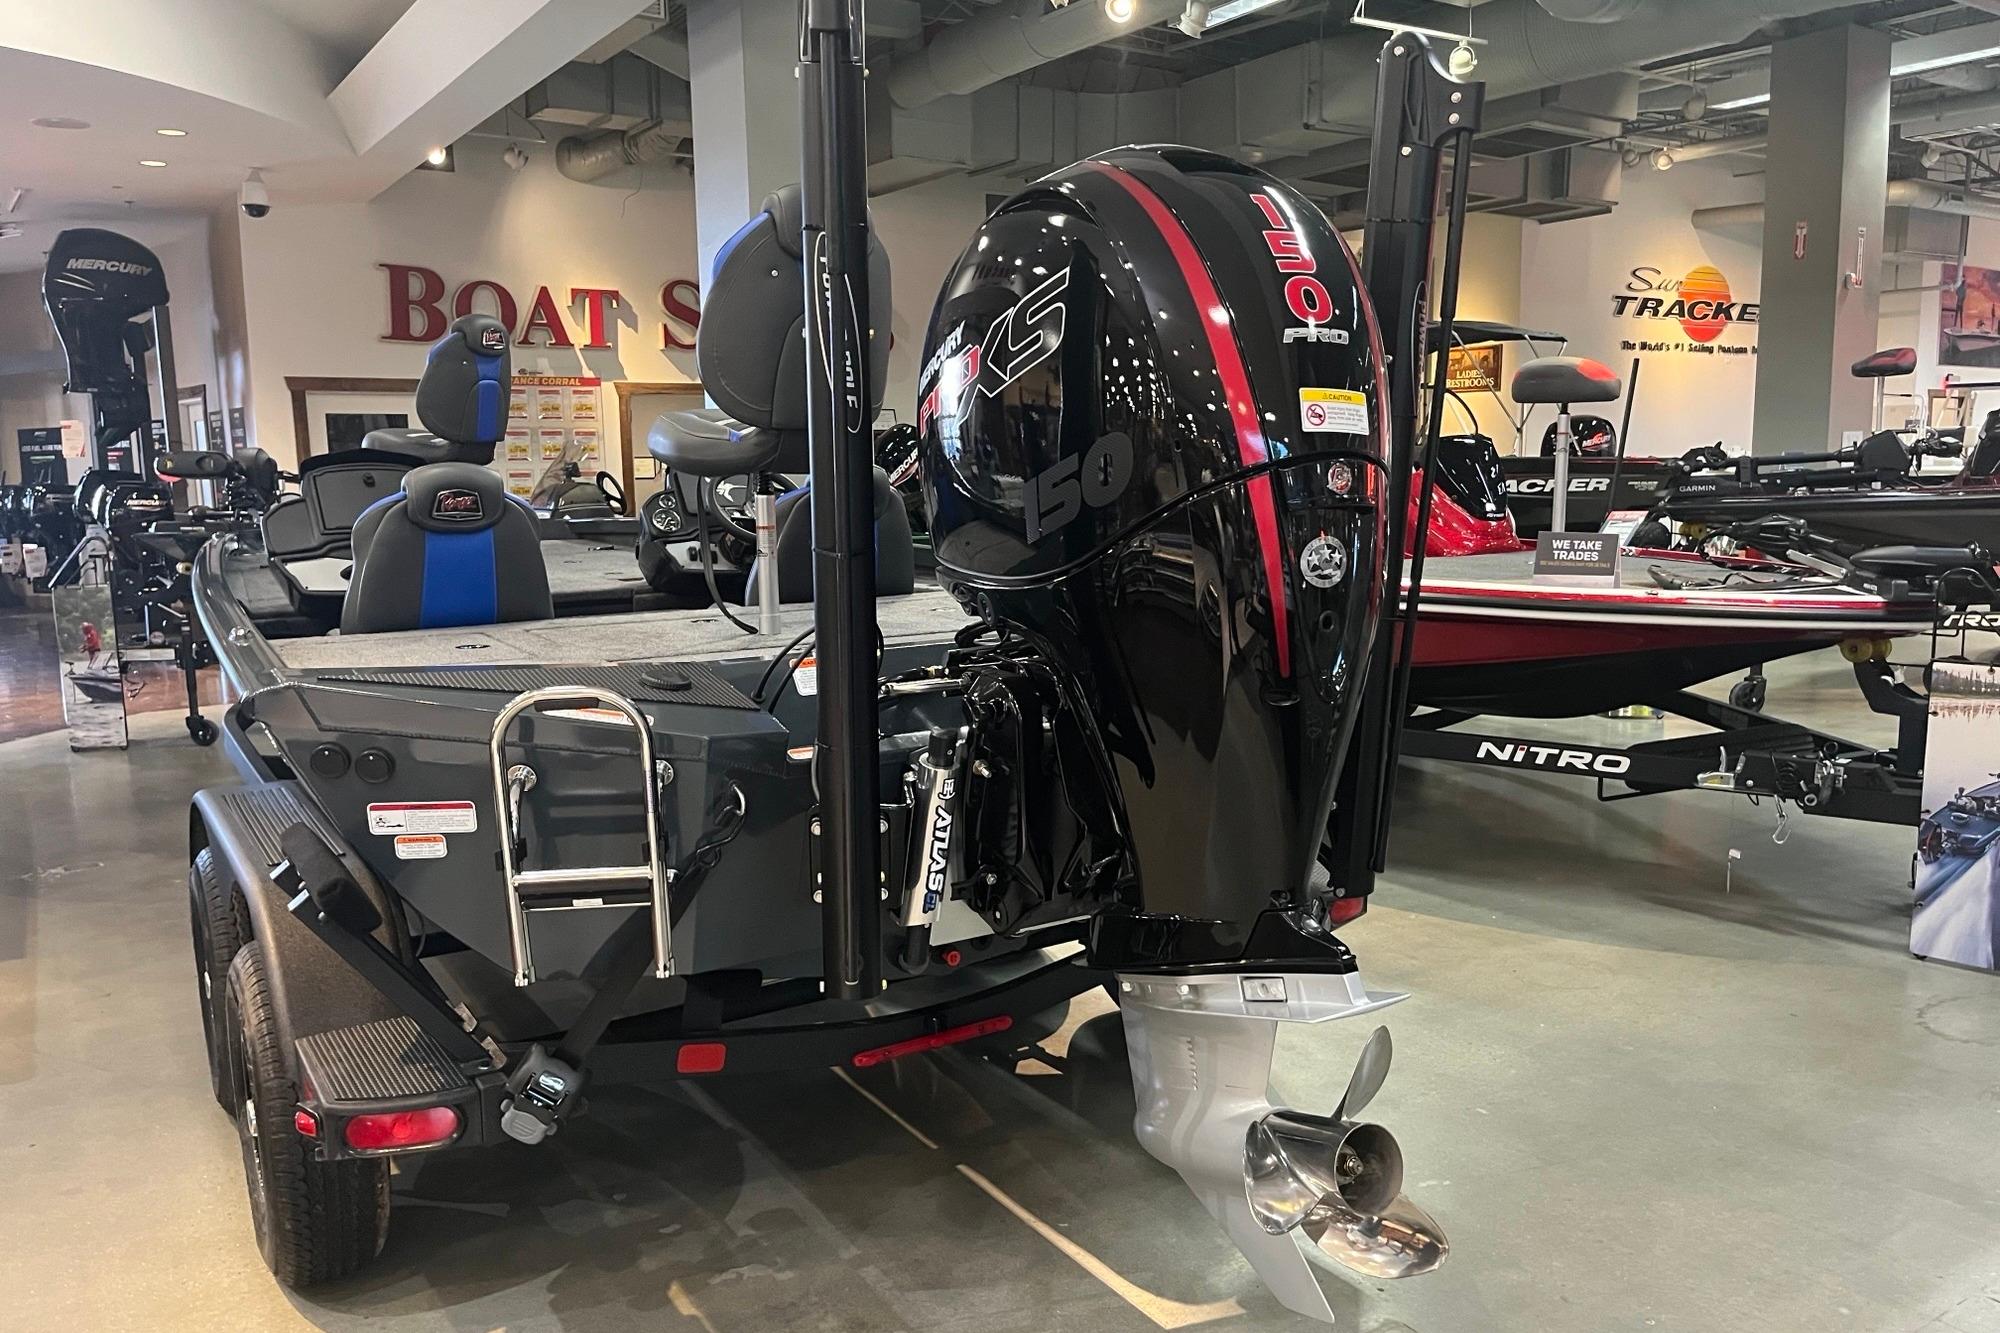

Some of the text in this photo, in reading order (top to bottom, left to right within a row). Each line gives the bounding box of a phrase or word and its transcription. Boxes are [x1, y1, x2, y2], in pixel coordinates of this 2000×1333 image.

[66, 257, 153, 277] MERCURY
[1250, 193, 1334, 325] 150
[377, 262, 622, 350] BOAT
[1611, 294, 1761, 323] TRACKE
[1282, 327, 1350, 346] PRO
[1620, 340, 1637, 351] The
[1688, 343, 1715, 354] Selling
[511, 377, 582, 387] ANCE CORRAL
[1328, 393, 1352, 401] CAUTION
[889, 446, 919, 484] MERCUR
[1023, 431, 1134, 545] 150
[1505, 478, 1610, 493] ACER
[1679, 484, 1716, 493] GARMIN
[1552, 539, 1603, 550] WE TAKE
[1553, 550, 1599, 561] TRADES
[1942, 613, 2000, 627] TRO
[927, 806, 952, 894] ATLAS
